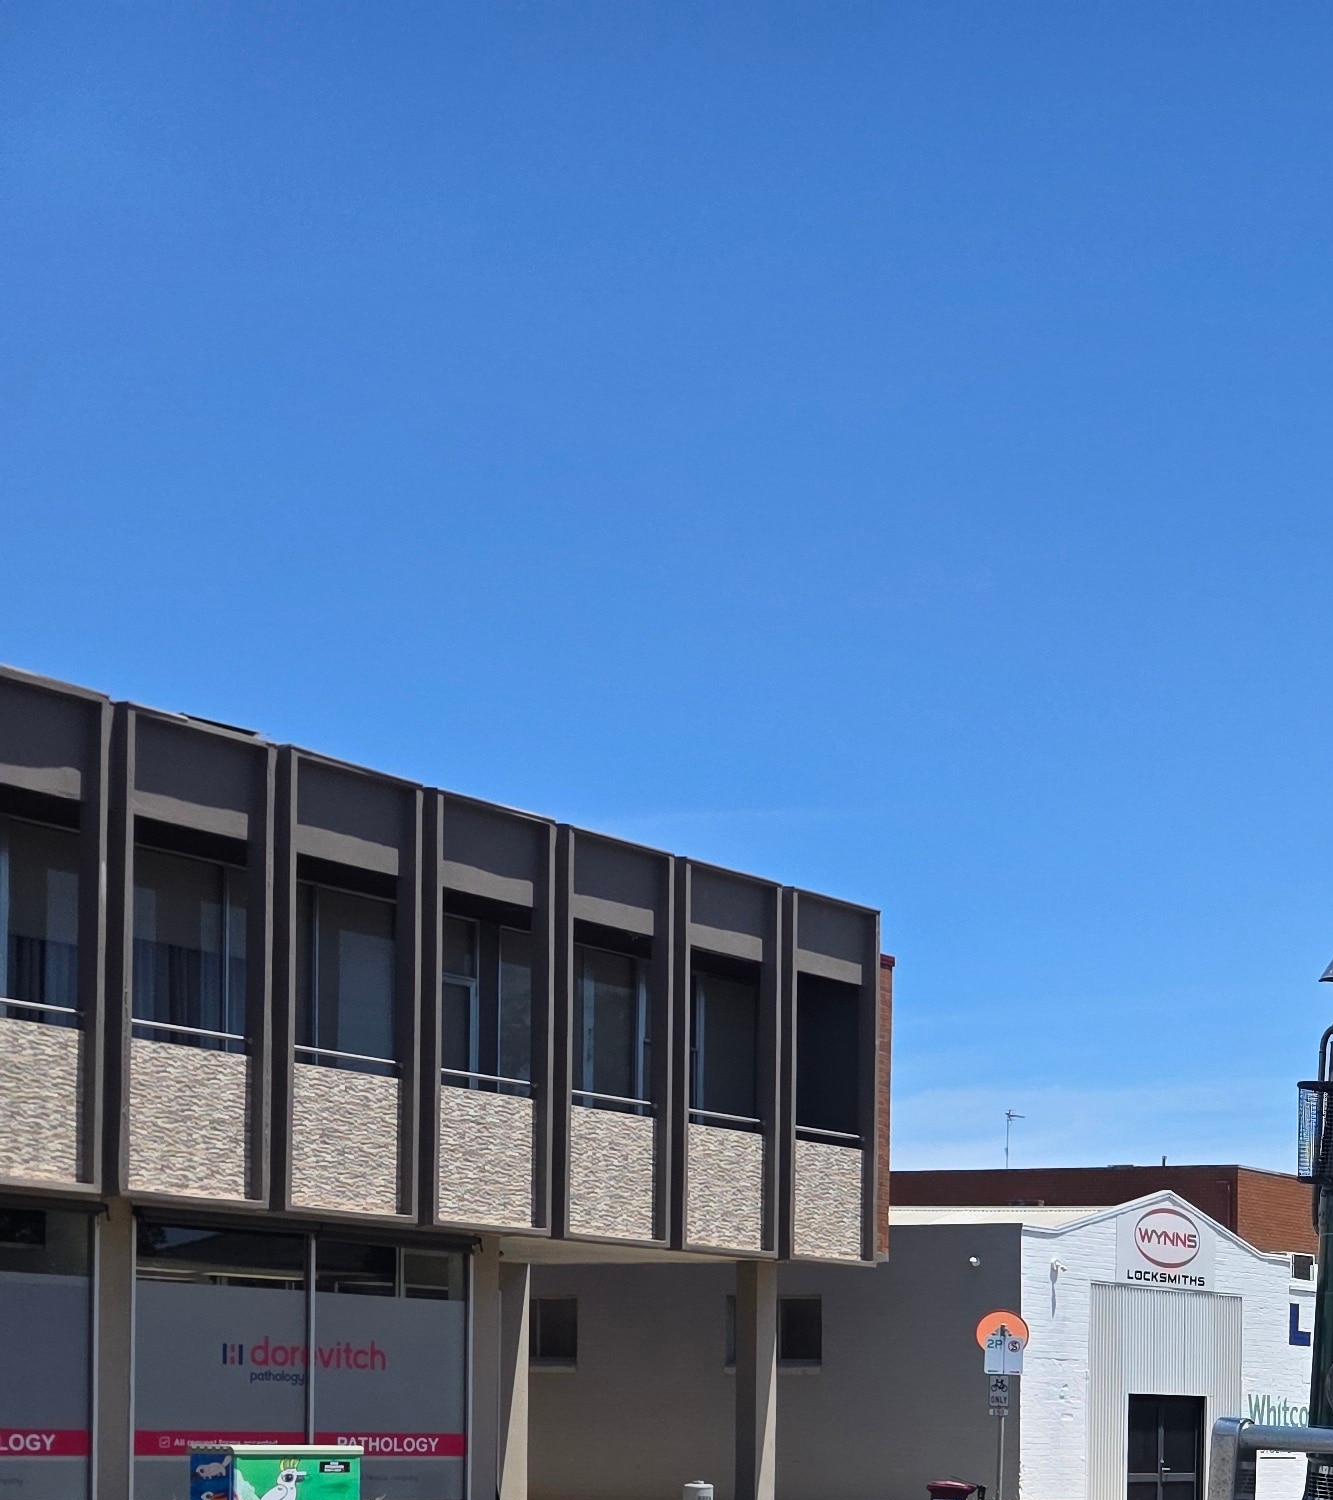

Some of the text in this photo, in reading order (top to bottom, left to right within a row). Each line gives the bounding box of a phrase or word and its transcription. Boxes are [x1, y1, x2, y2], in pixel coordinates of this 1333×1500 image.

[1138, 1227, 1197, 1249] WYNNS
[1127, 1269, 1205, 1287] LOCKSMITHS
[987, 1339, 1003, 1349] 2P
[249, 1370, 306, 1386] pathology
[337, 1436, 439, 1452] PATHOLOGY
